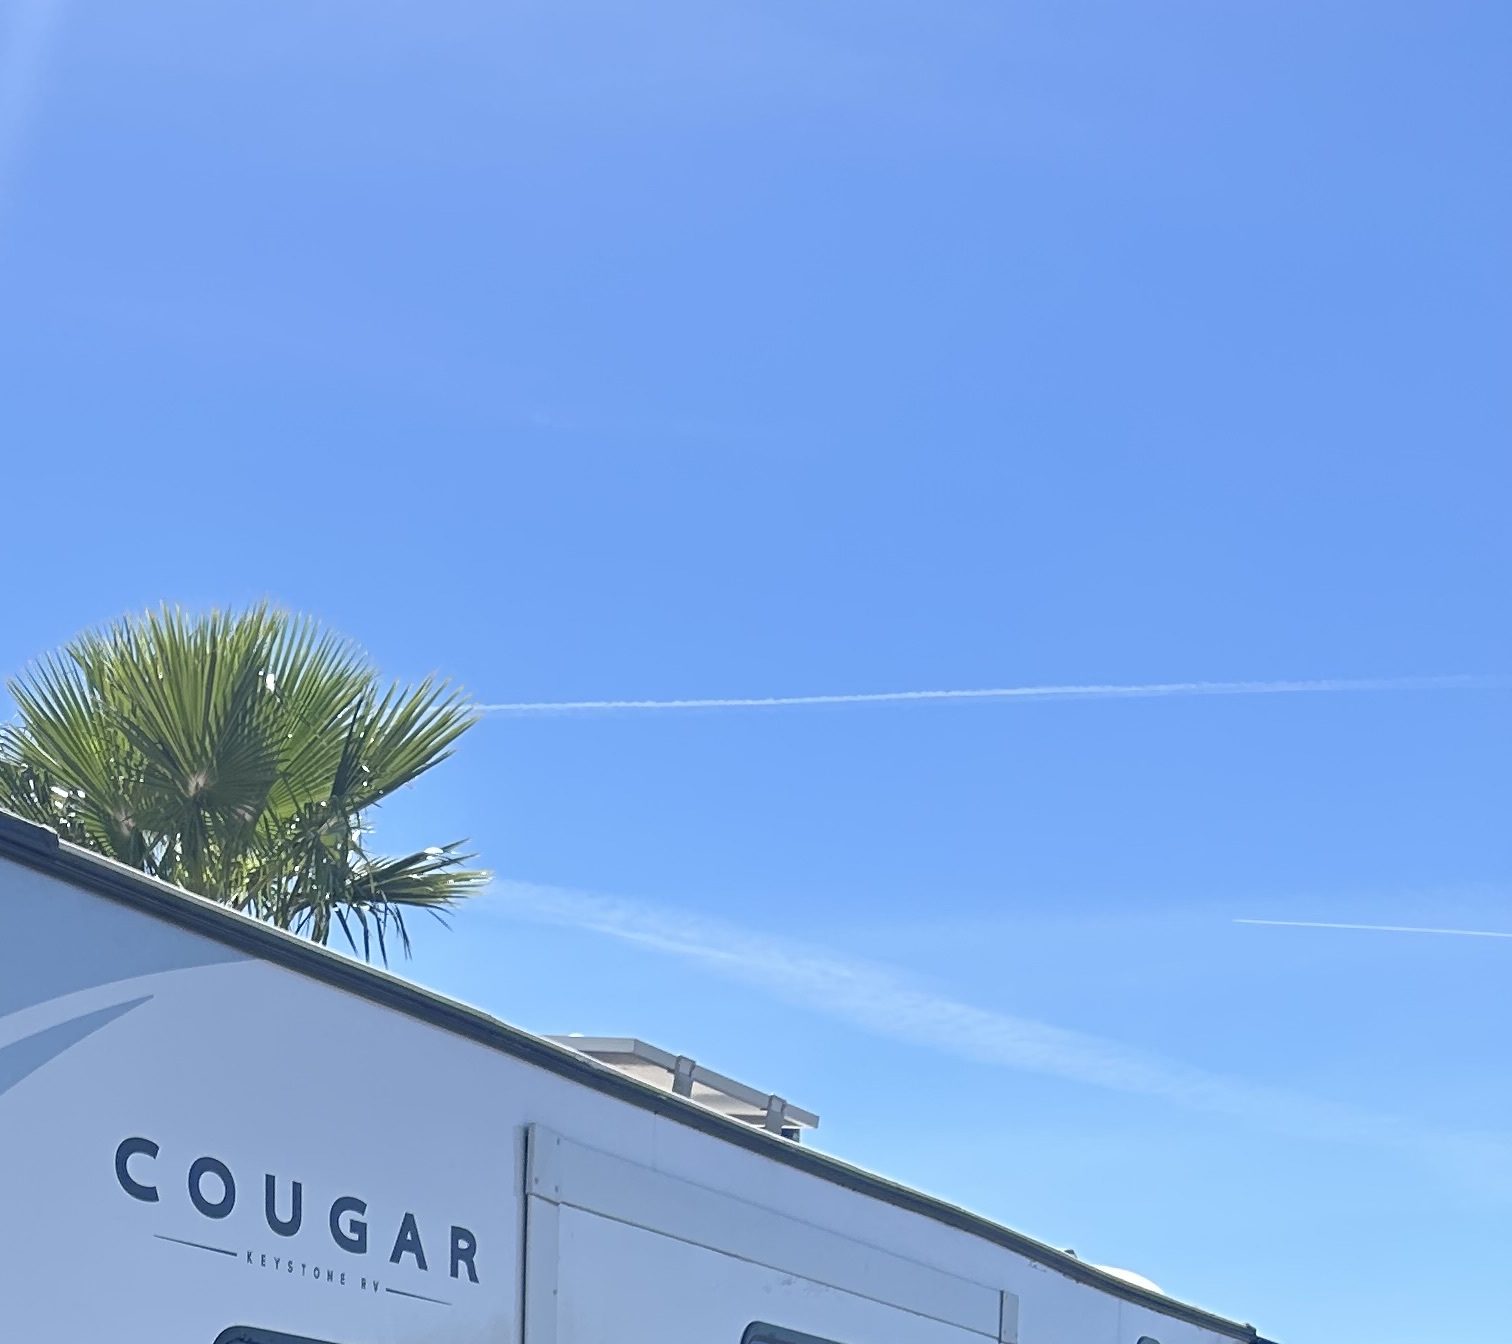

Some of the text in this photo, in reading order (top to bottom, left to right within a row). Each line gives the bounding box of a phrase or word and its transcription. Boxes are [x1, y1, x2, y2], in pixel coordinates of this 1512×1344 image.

[114, 1136, 480, 1283] COUGAR
[246, 1251, 380, 1293] KEYSTONE RV
